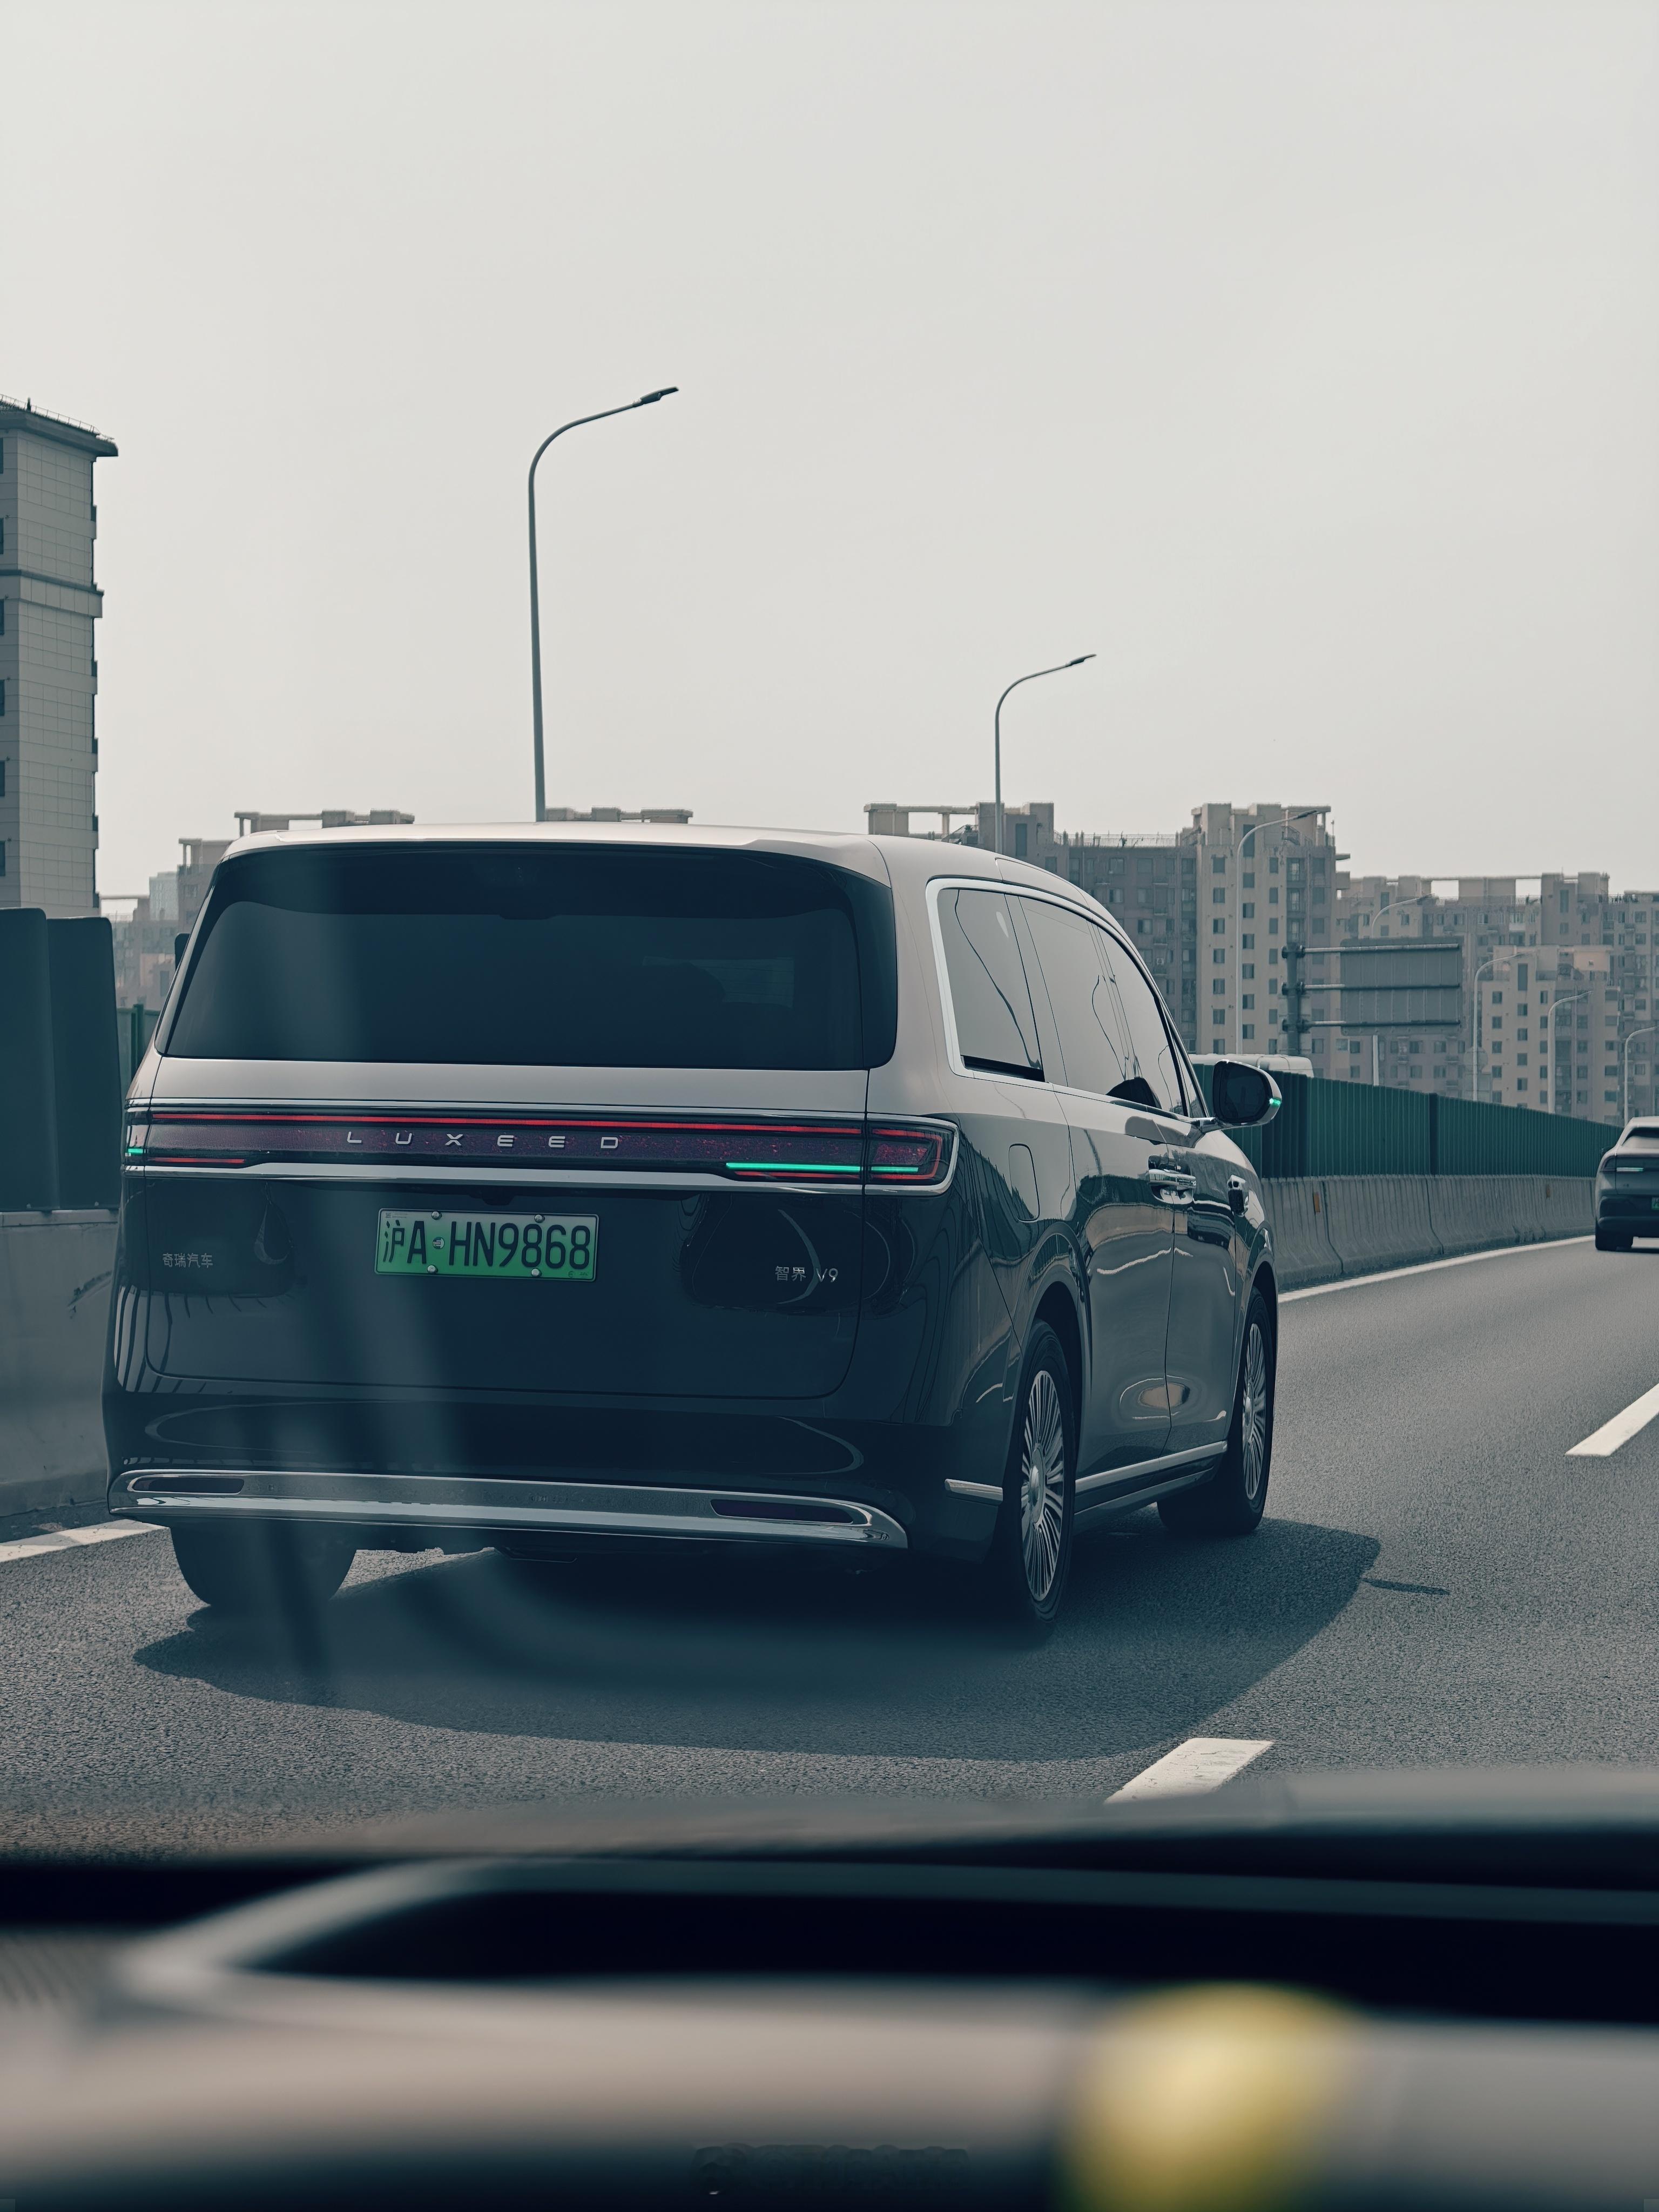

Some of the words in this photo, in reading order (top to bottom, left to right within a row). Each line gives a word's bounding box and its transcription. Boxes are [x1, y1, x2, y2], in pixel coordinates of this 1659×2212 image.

[346, 1131, 619, 1149] LUXEED
[163, 1252, 213, 1268] 奇瑞汽车
[775, 1265, 806, 1282] 智界
[816, 1268, 839, 1282] V9
